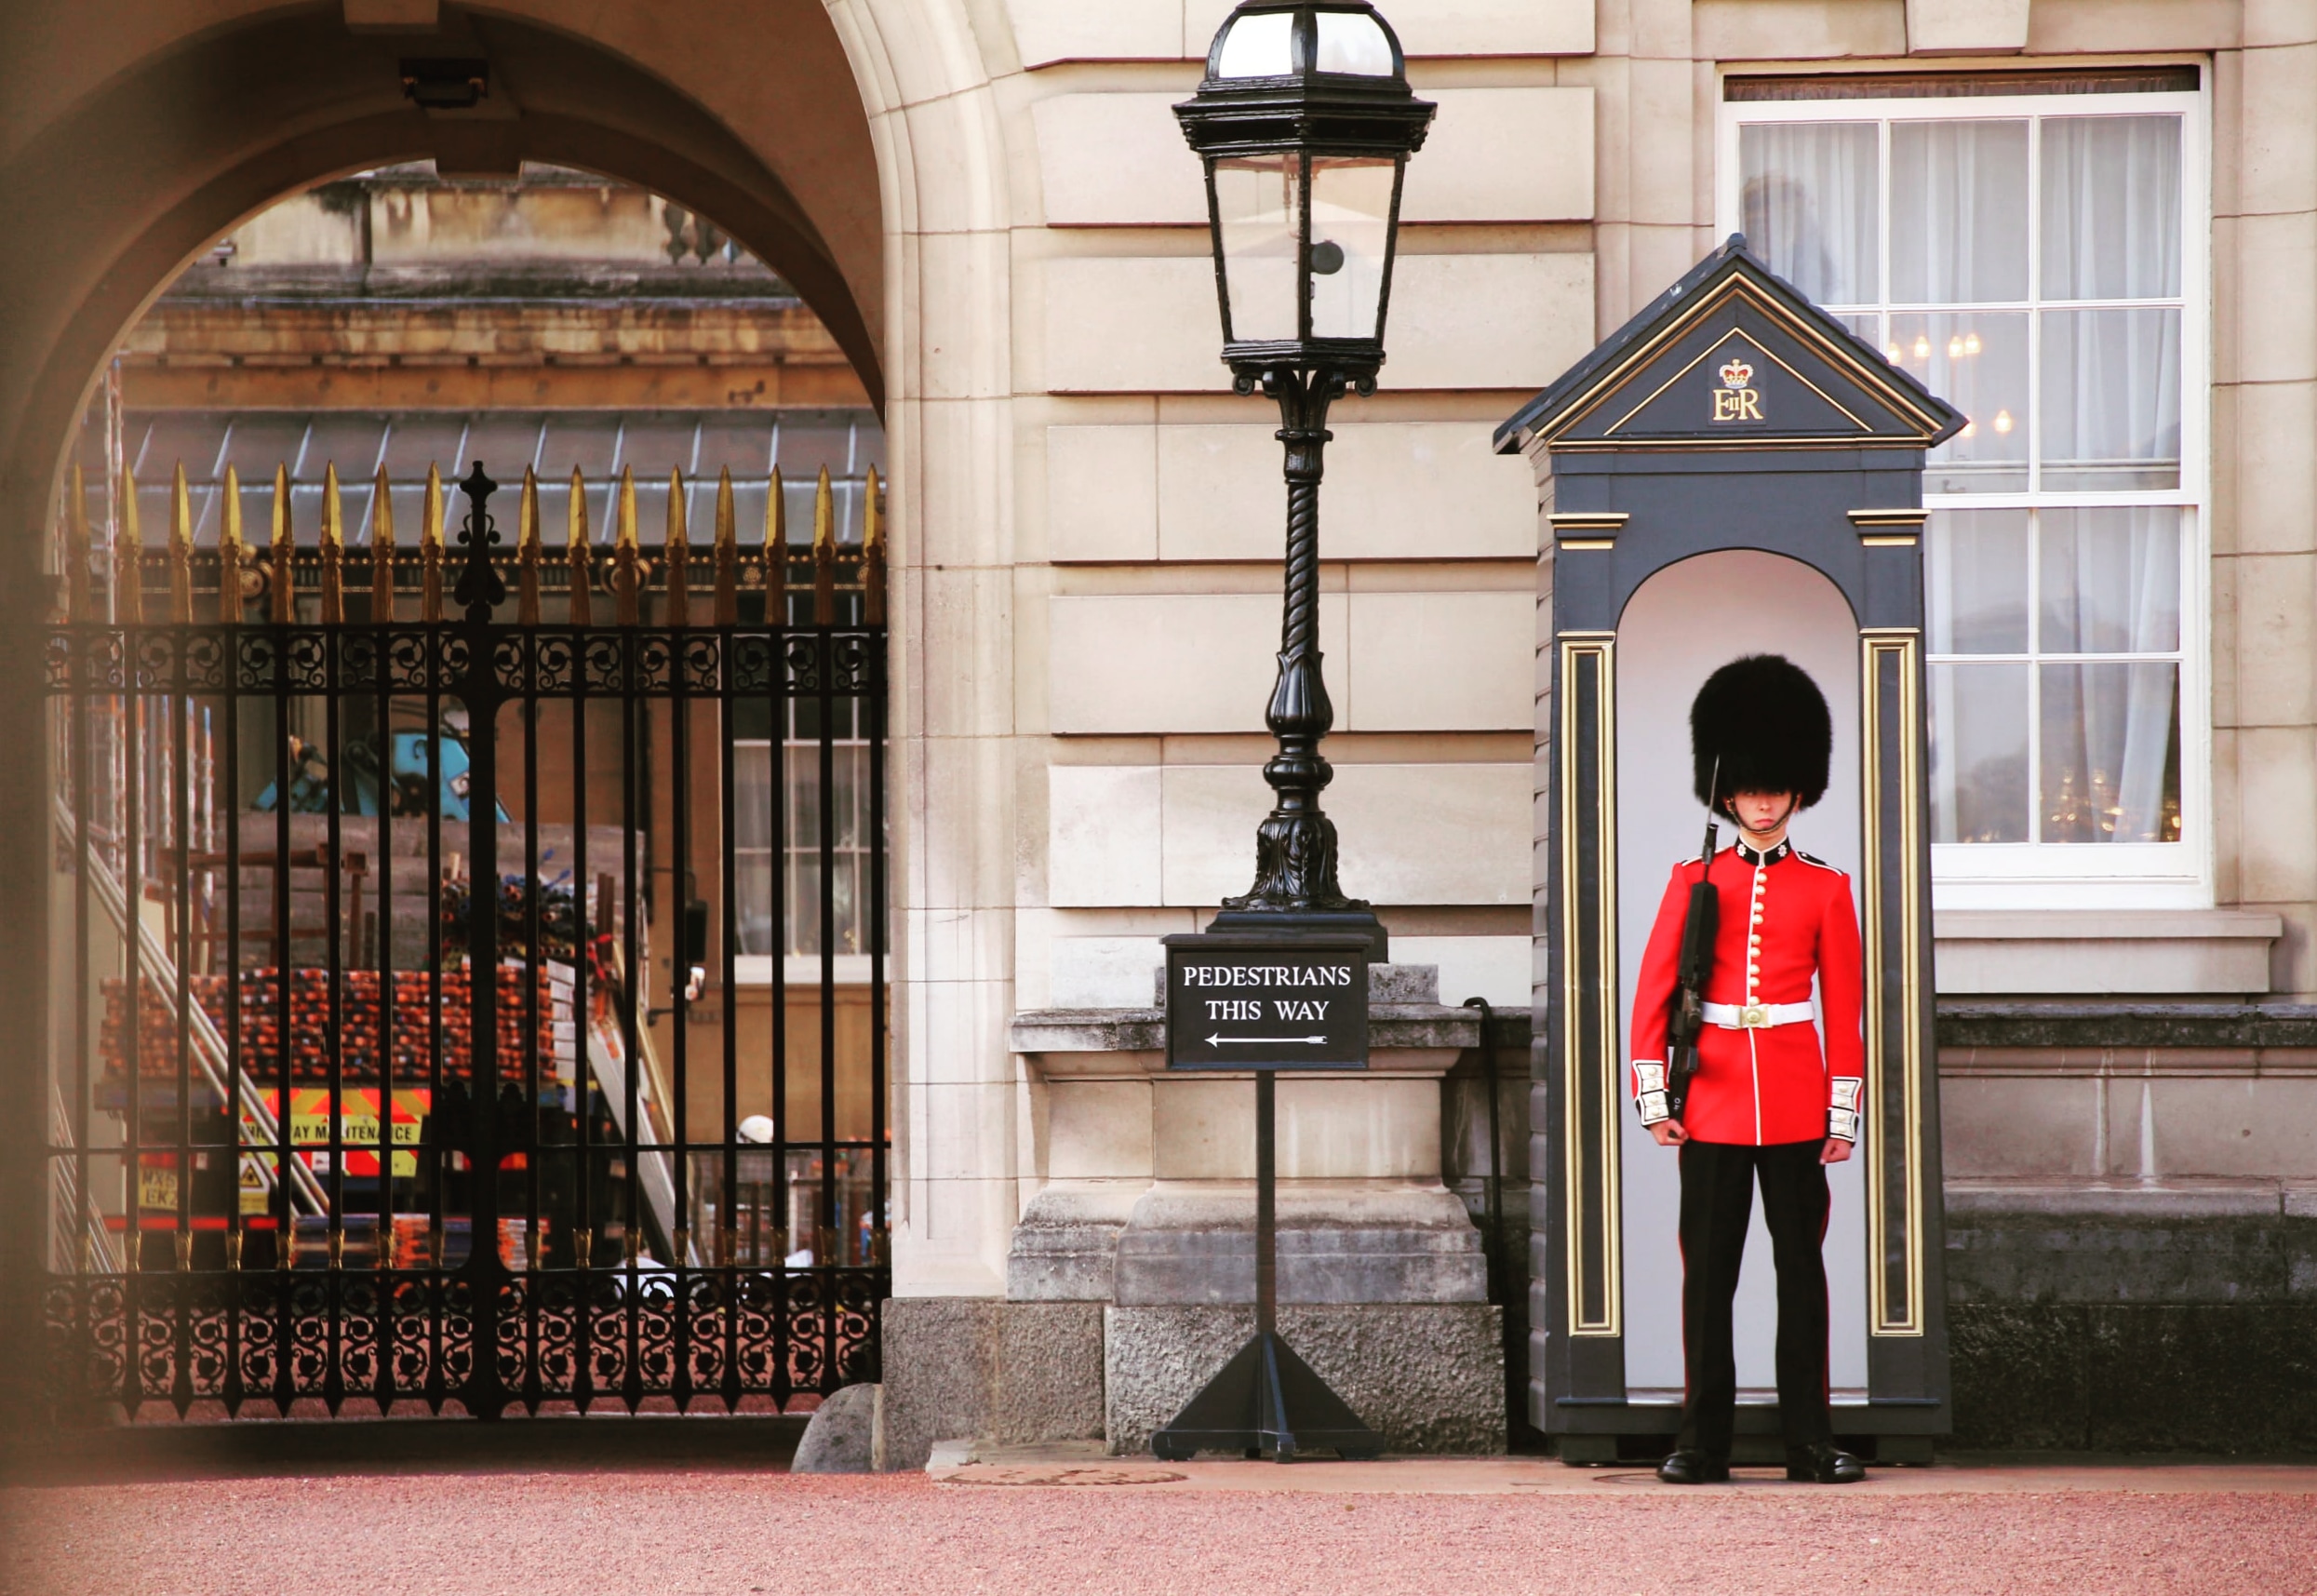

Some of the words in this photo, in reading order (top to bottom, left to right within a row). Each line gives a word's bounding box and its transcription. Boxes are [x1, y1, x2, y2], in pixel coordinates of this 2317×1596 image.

[1183, 966, 1351, 986] PEDESTRIANS
[1205, 999, 1262, 1020] THIS
[1273, 999, 1330, 1021] WAY
